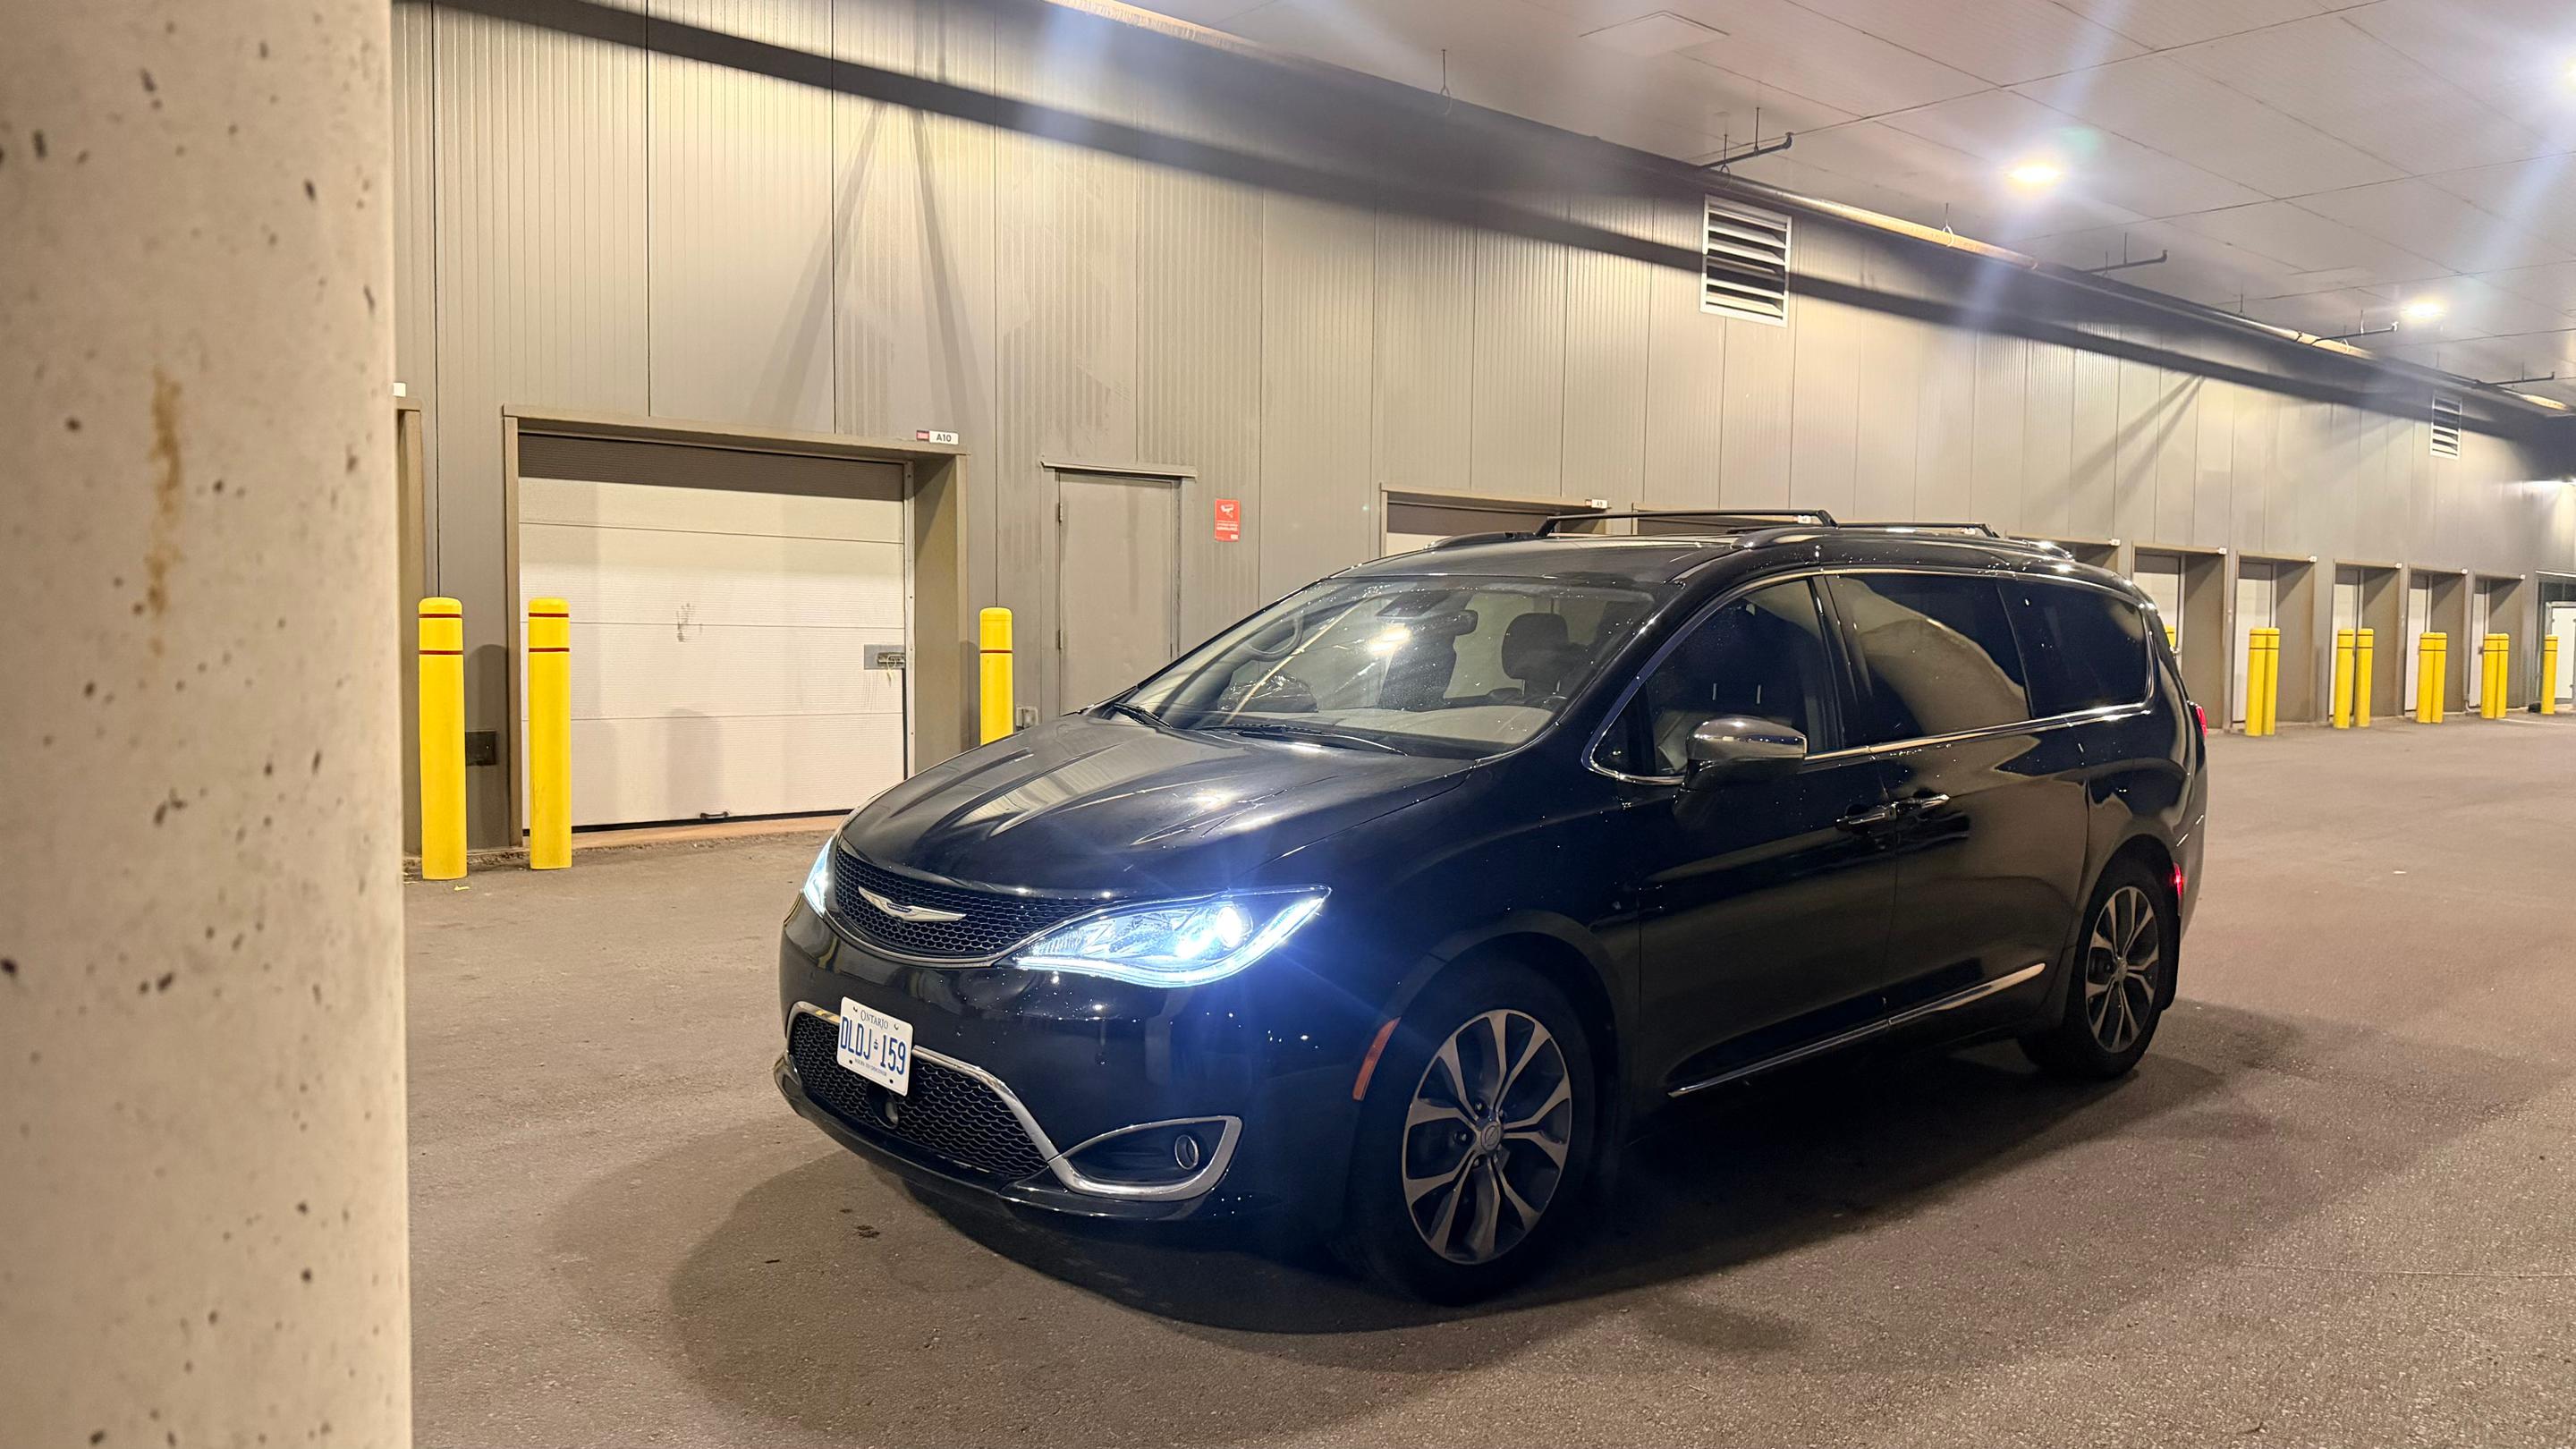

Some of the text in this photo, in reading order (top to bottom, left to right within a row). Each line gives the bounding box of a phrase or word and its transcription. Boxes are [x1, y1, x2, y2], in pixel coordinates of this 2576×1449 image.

[936, 433, 952, 442] A10
[860, 1010, 888, 1030] ONTARIO
[841, 1016, 872, 1060] DLDJ
[880, 1035, 906, 1075] 159
